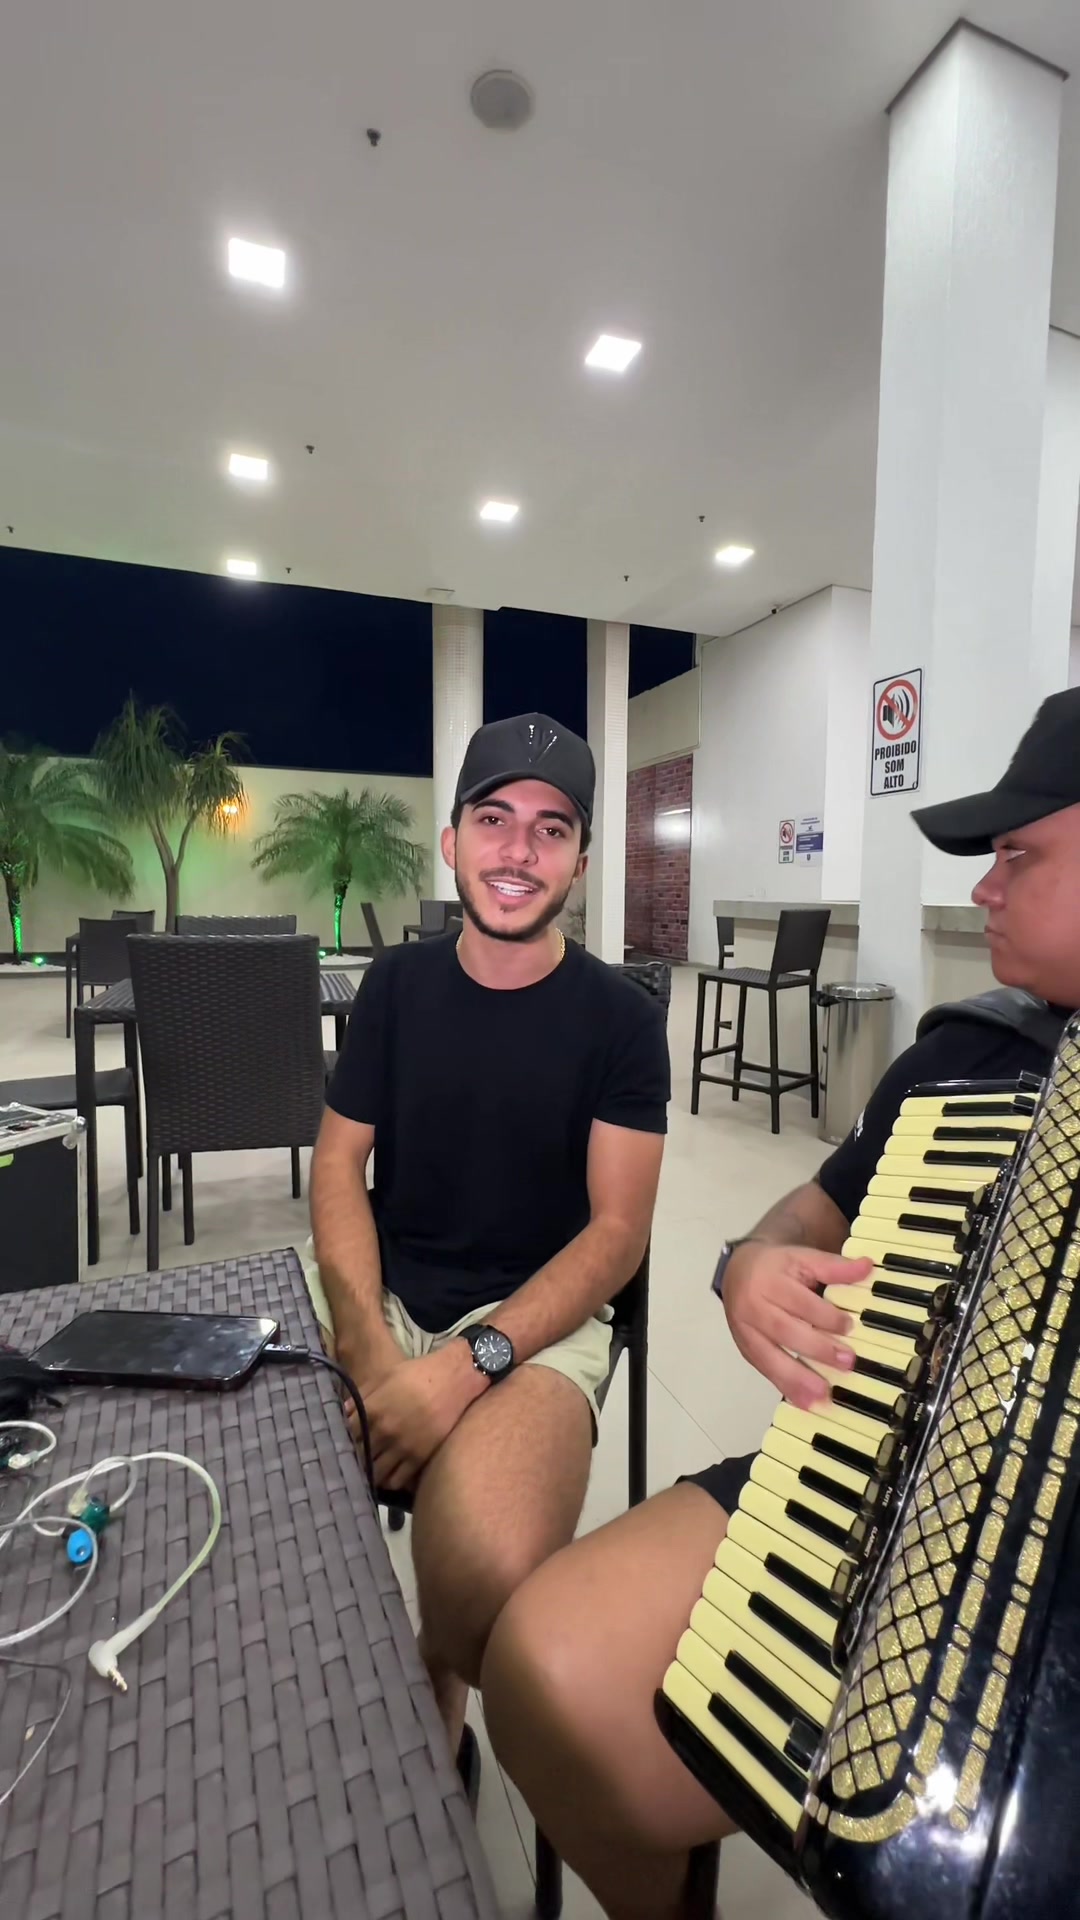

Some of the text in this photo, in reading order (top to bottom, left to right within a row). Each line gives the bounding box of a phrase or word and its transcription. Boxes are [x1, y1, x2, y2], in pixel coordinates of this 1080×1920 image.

[875, 740, 916, 760] PROIBIDO
[885, 759, 904, 774] SOM
[884, 774, 904, 789] ALTO
[883, 1486, 893, 1507] FLUTE
